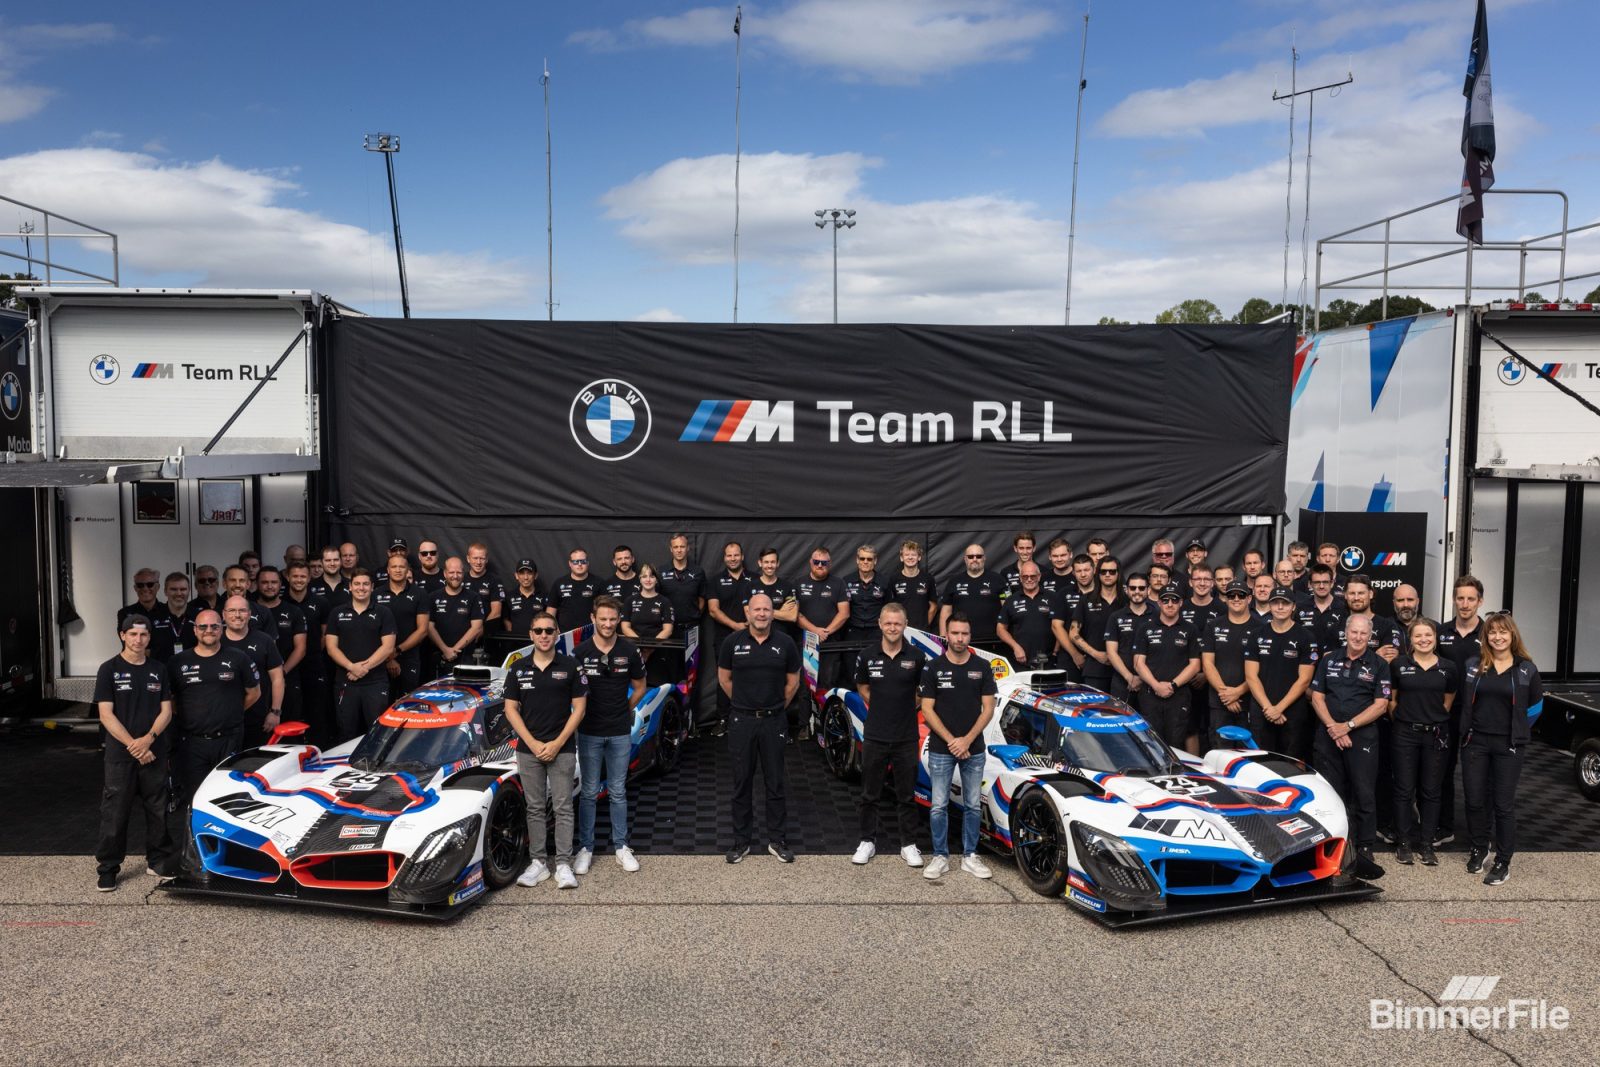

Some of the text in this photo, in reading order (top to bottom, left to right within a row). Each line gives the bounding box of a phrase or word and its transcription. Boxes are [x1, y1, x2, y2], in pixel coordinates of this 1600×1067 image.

[181, 363, 233, 380] Team
[240, 365, 277, 381] RLL
[816, 400, 955, 443] Team
[972, 401, 1072, 442] RLL
[1370, 579, 1402, 590] rsport
[1153, 776, 1200, 791] 24
[343, 826, 378, 835] CHAMPION
[1075, 894, 1102, 909] MICHELIN
